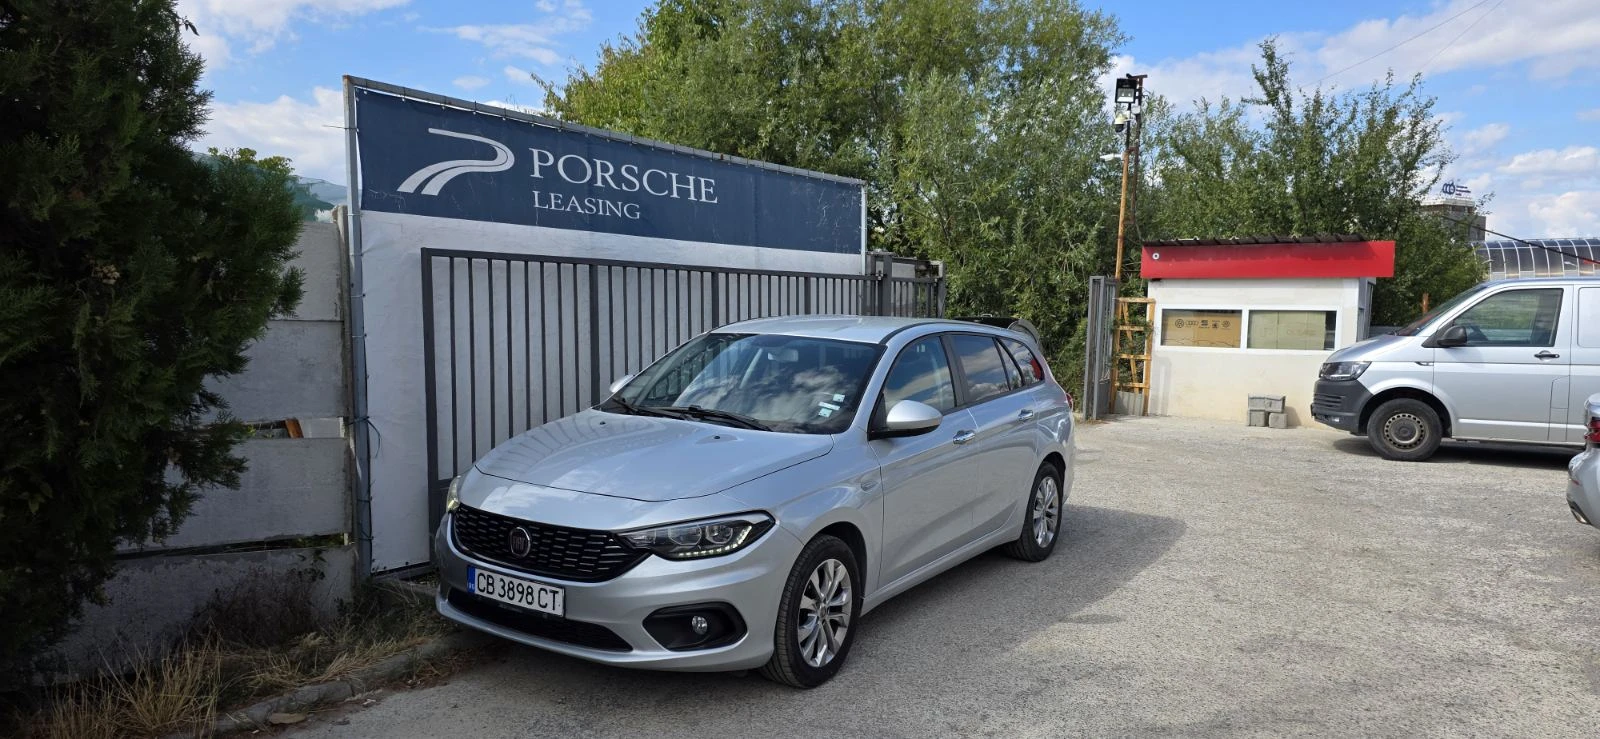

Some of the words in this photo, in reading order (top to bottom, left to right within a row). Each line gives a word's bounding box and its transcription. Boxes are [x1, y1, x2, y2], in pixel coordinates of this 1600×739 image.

[529, 147, 718, 204] PORSCHE
[532, 190, 641, 220] LEASING
[477, 573, 496, 595] CB
[498, 578, 534, 605] 3898
[538, 588, 559, 611] CT
